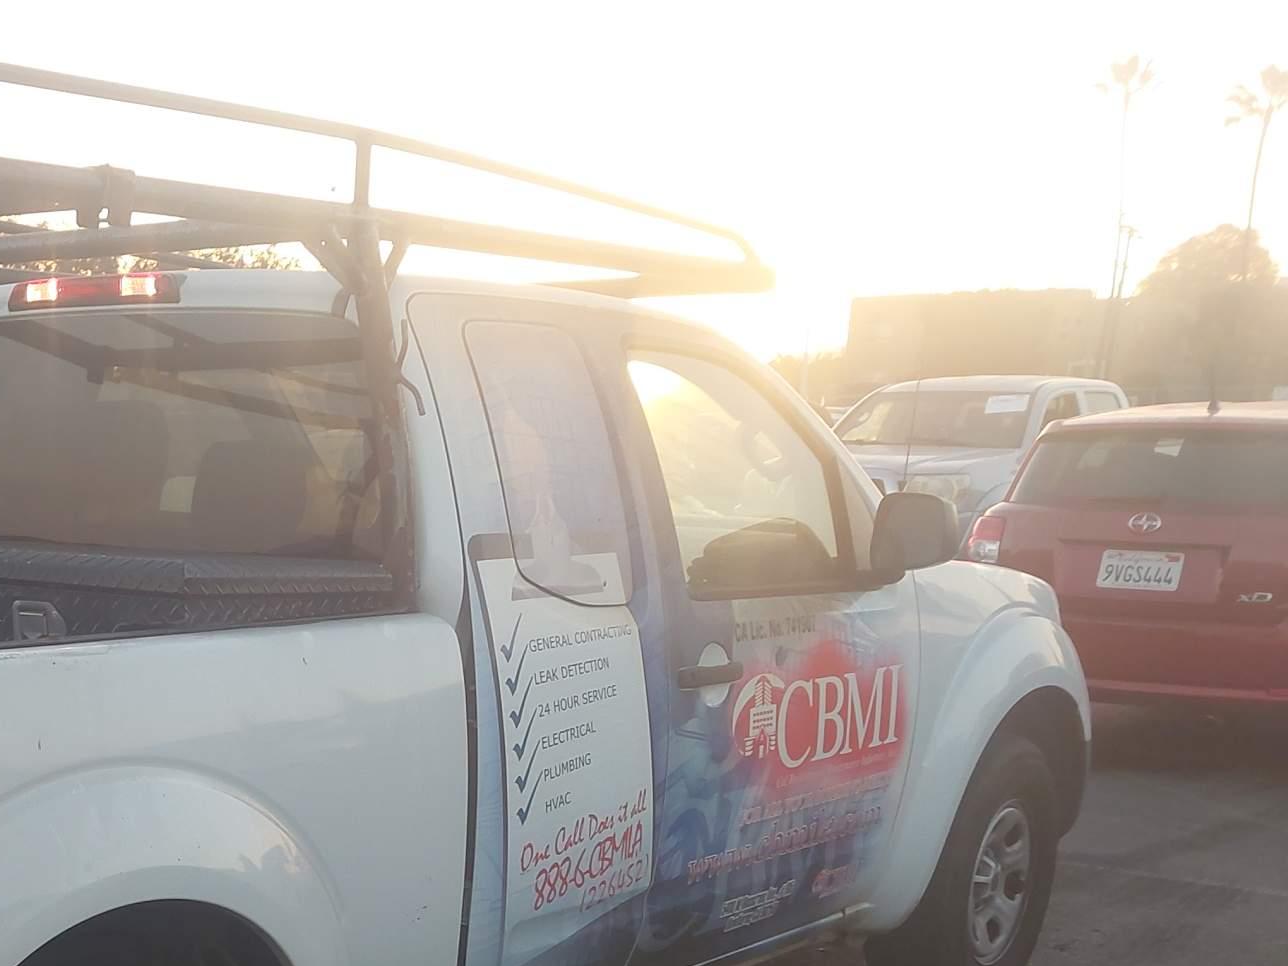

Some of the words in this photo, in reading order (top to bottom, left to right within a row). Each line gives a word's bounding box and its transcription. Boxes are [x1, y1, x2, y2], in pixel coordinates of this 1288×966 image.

[1102, 563, 1173, 586] 9VGS444
[528, 632, 574, 653] GENERAL
[574, 624, 632, 645] CONTRACTING
[533, 668, 560, 686] LEAK
[560, 656, 610, 680] DETECTION
[537, 703, 551, 718] 24
[553, 695, 580, 713] HOUR
[582, 684, 617, 705] SERVICE
[777, 664, 904, 769] CBMI
[541, 721, 596, 750] ELECTRICAL
[543, 752, 592, 782] PLUMBING
[545, 791, 572, 814] HVAC
[520, 842, 551, 873] One
[554, 816, 585, 855] Call
[587, 813, 615, 841] Does
[617, 801, 629, 823] it
[630, 788, 648, 819] all
